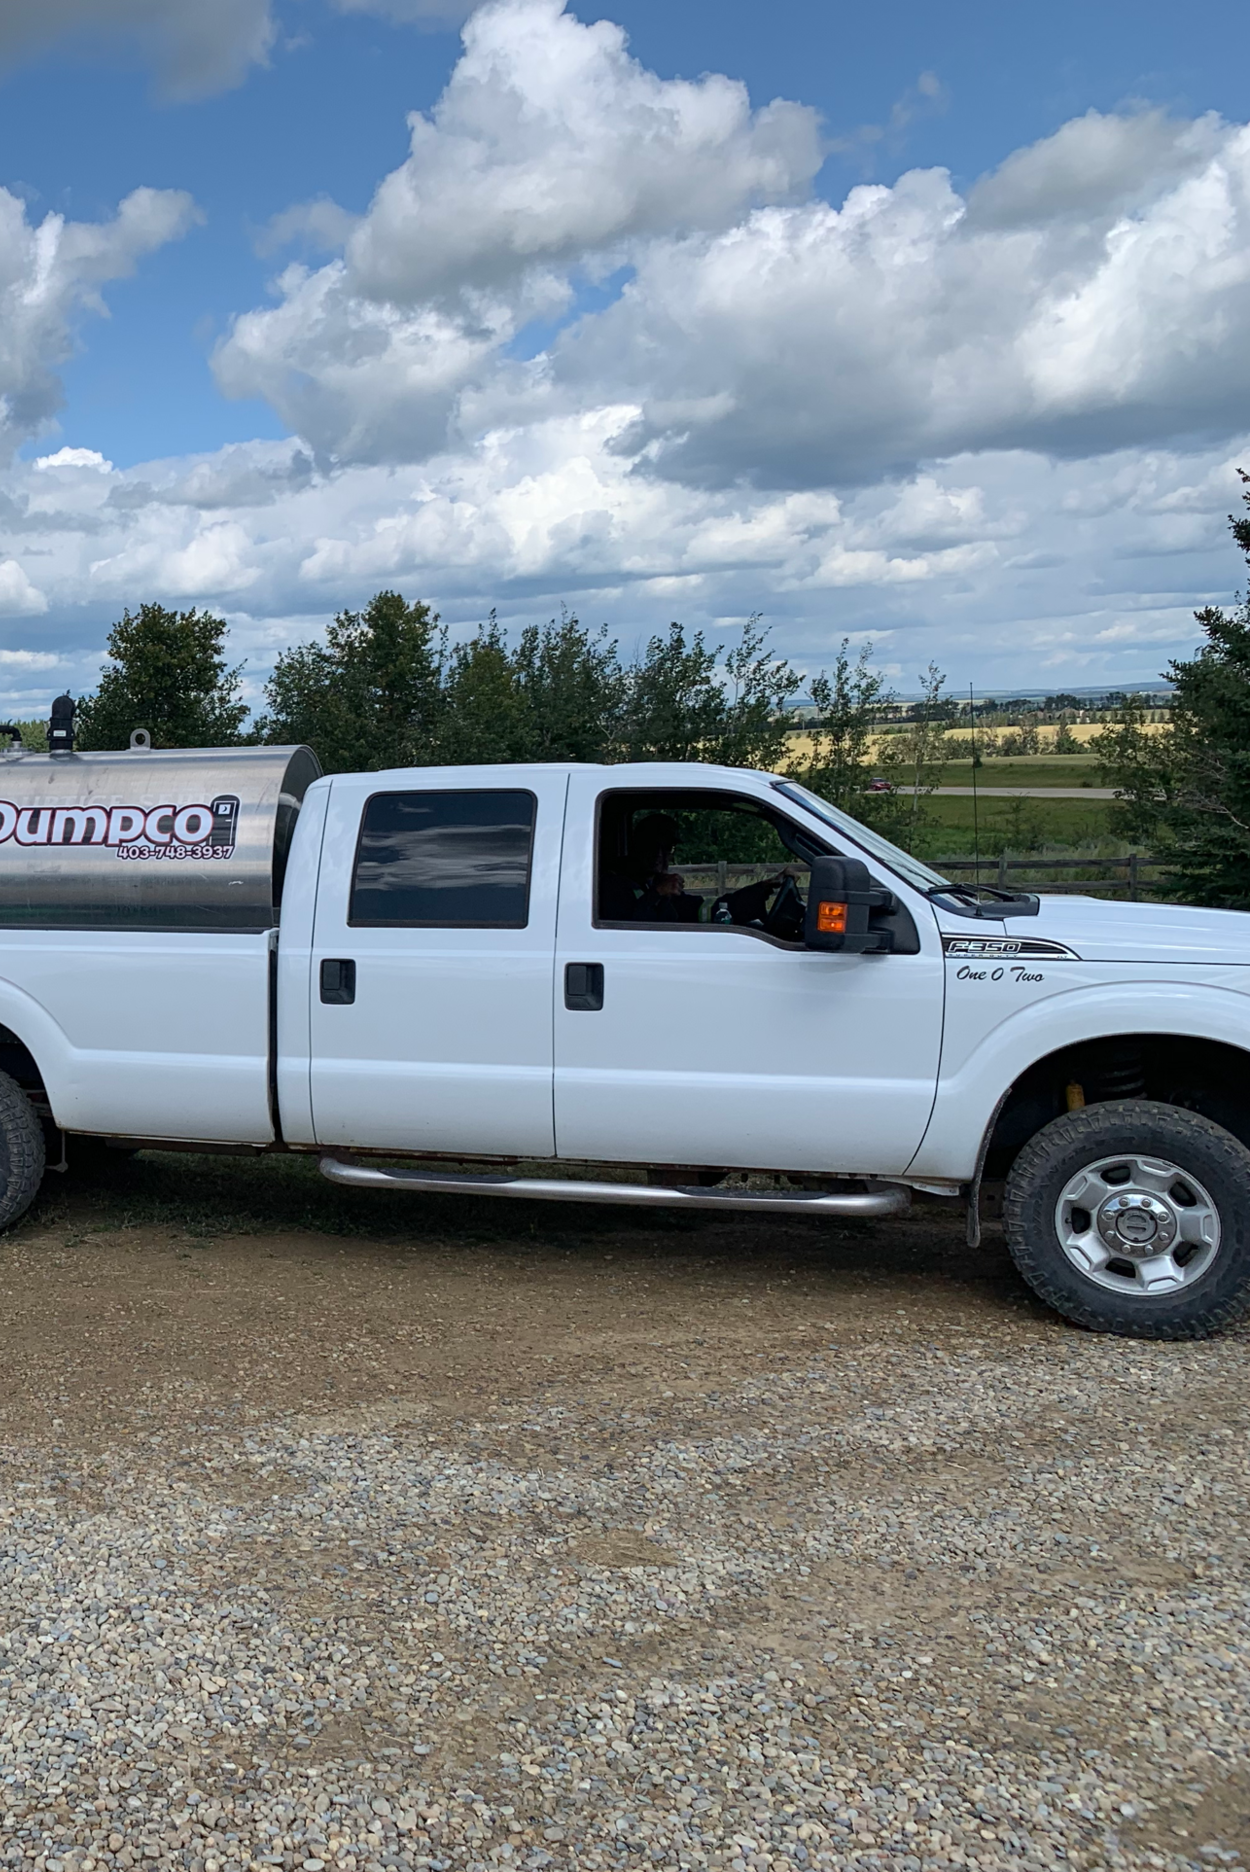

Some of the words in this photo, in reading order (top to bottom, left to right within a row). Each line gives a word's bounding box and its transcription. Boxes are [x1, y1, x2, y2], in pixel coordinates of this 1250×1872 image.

[117, 845, 234, 860] 403-748-3937
[956, 965, 987, 981] One
[1010, 966, 1044, 982] Two
